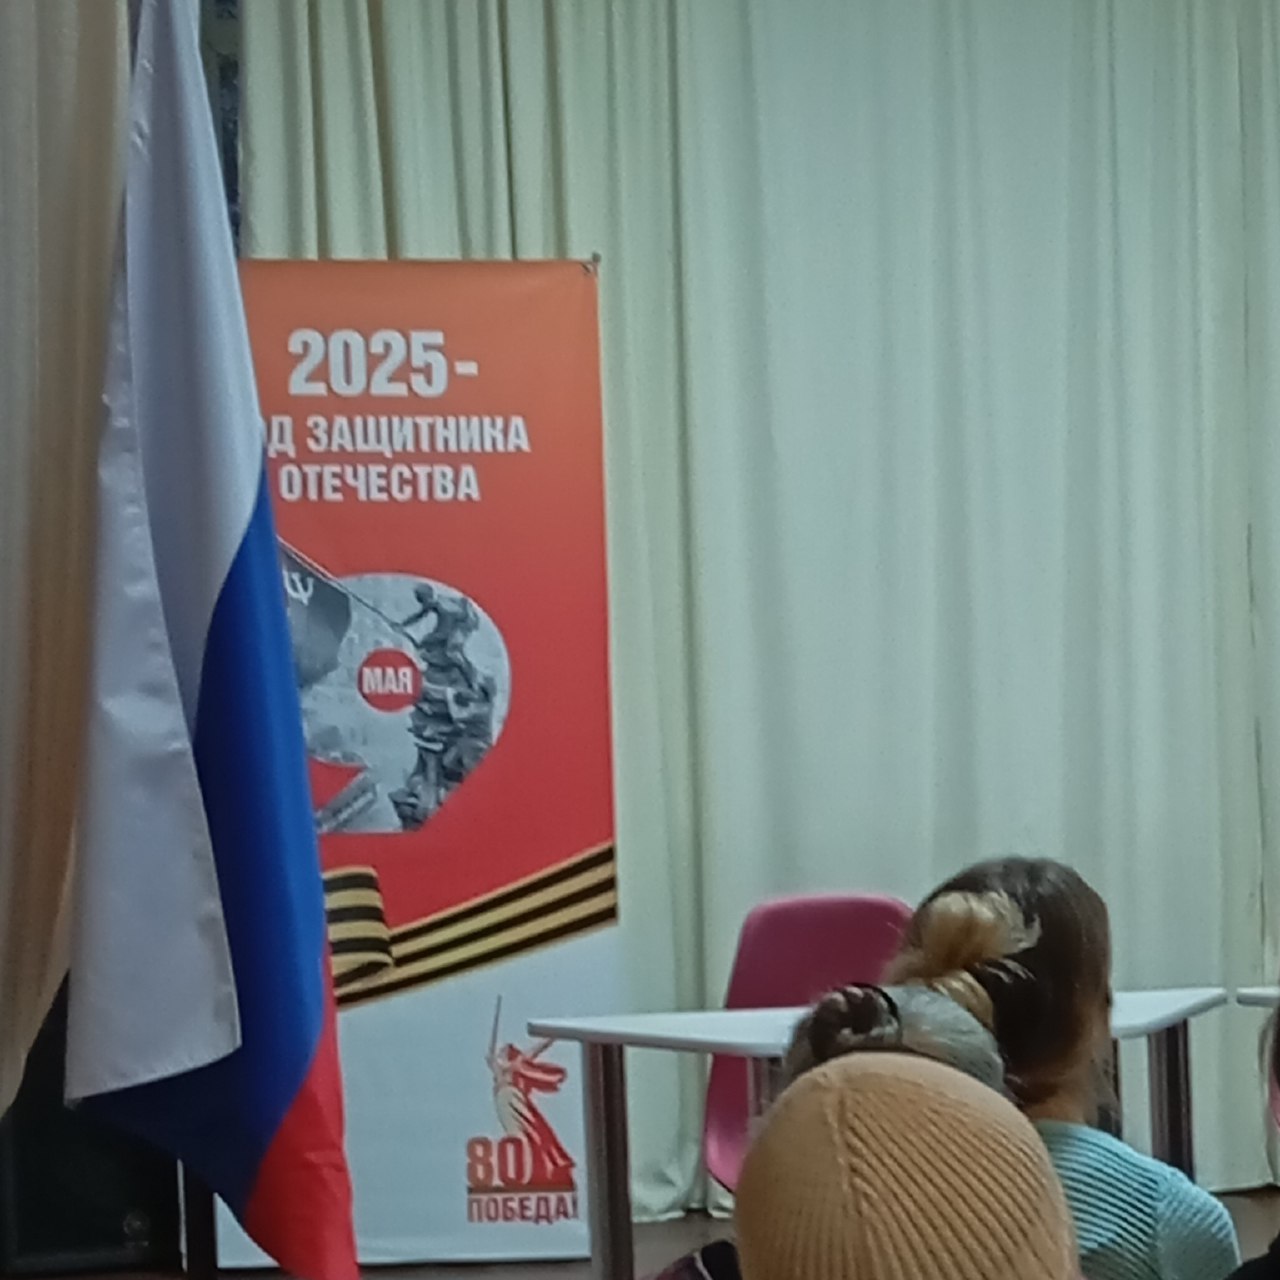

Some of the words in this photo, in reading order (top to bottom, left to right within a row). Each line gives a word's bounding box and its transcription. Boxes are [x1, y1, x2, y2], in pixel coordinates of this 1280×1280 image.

[286, 327, 480, 399] 2025-
[305, 414, 532, 459] ЗАЩИТНИКА
[278, 463, 481, 502] ОТЕЧЕСТВА
[361, 665, 414, 695] МАЯ
[466, 1135, 528, 1188] 80
[466, 1194, 580, 1225] ПОБЕДА!
